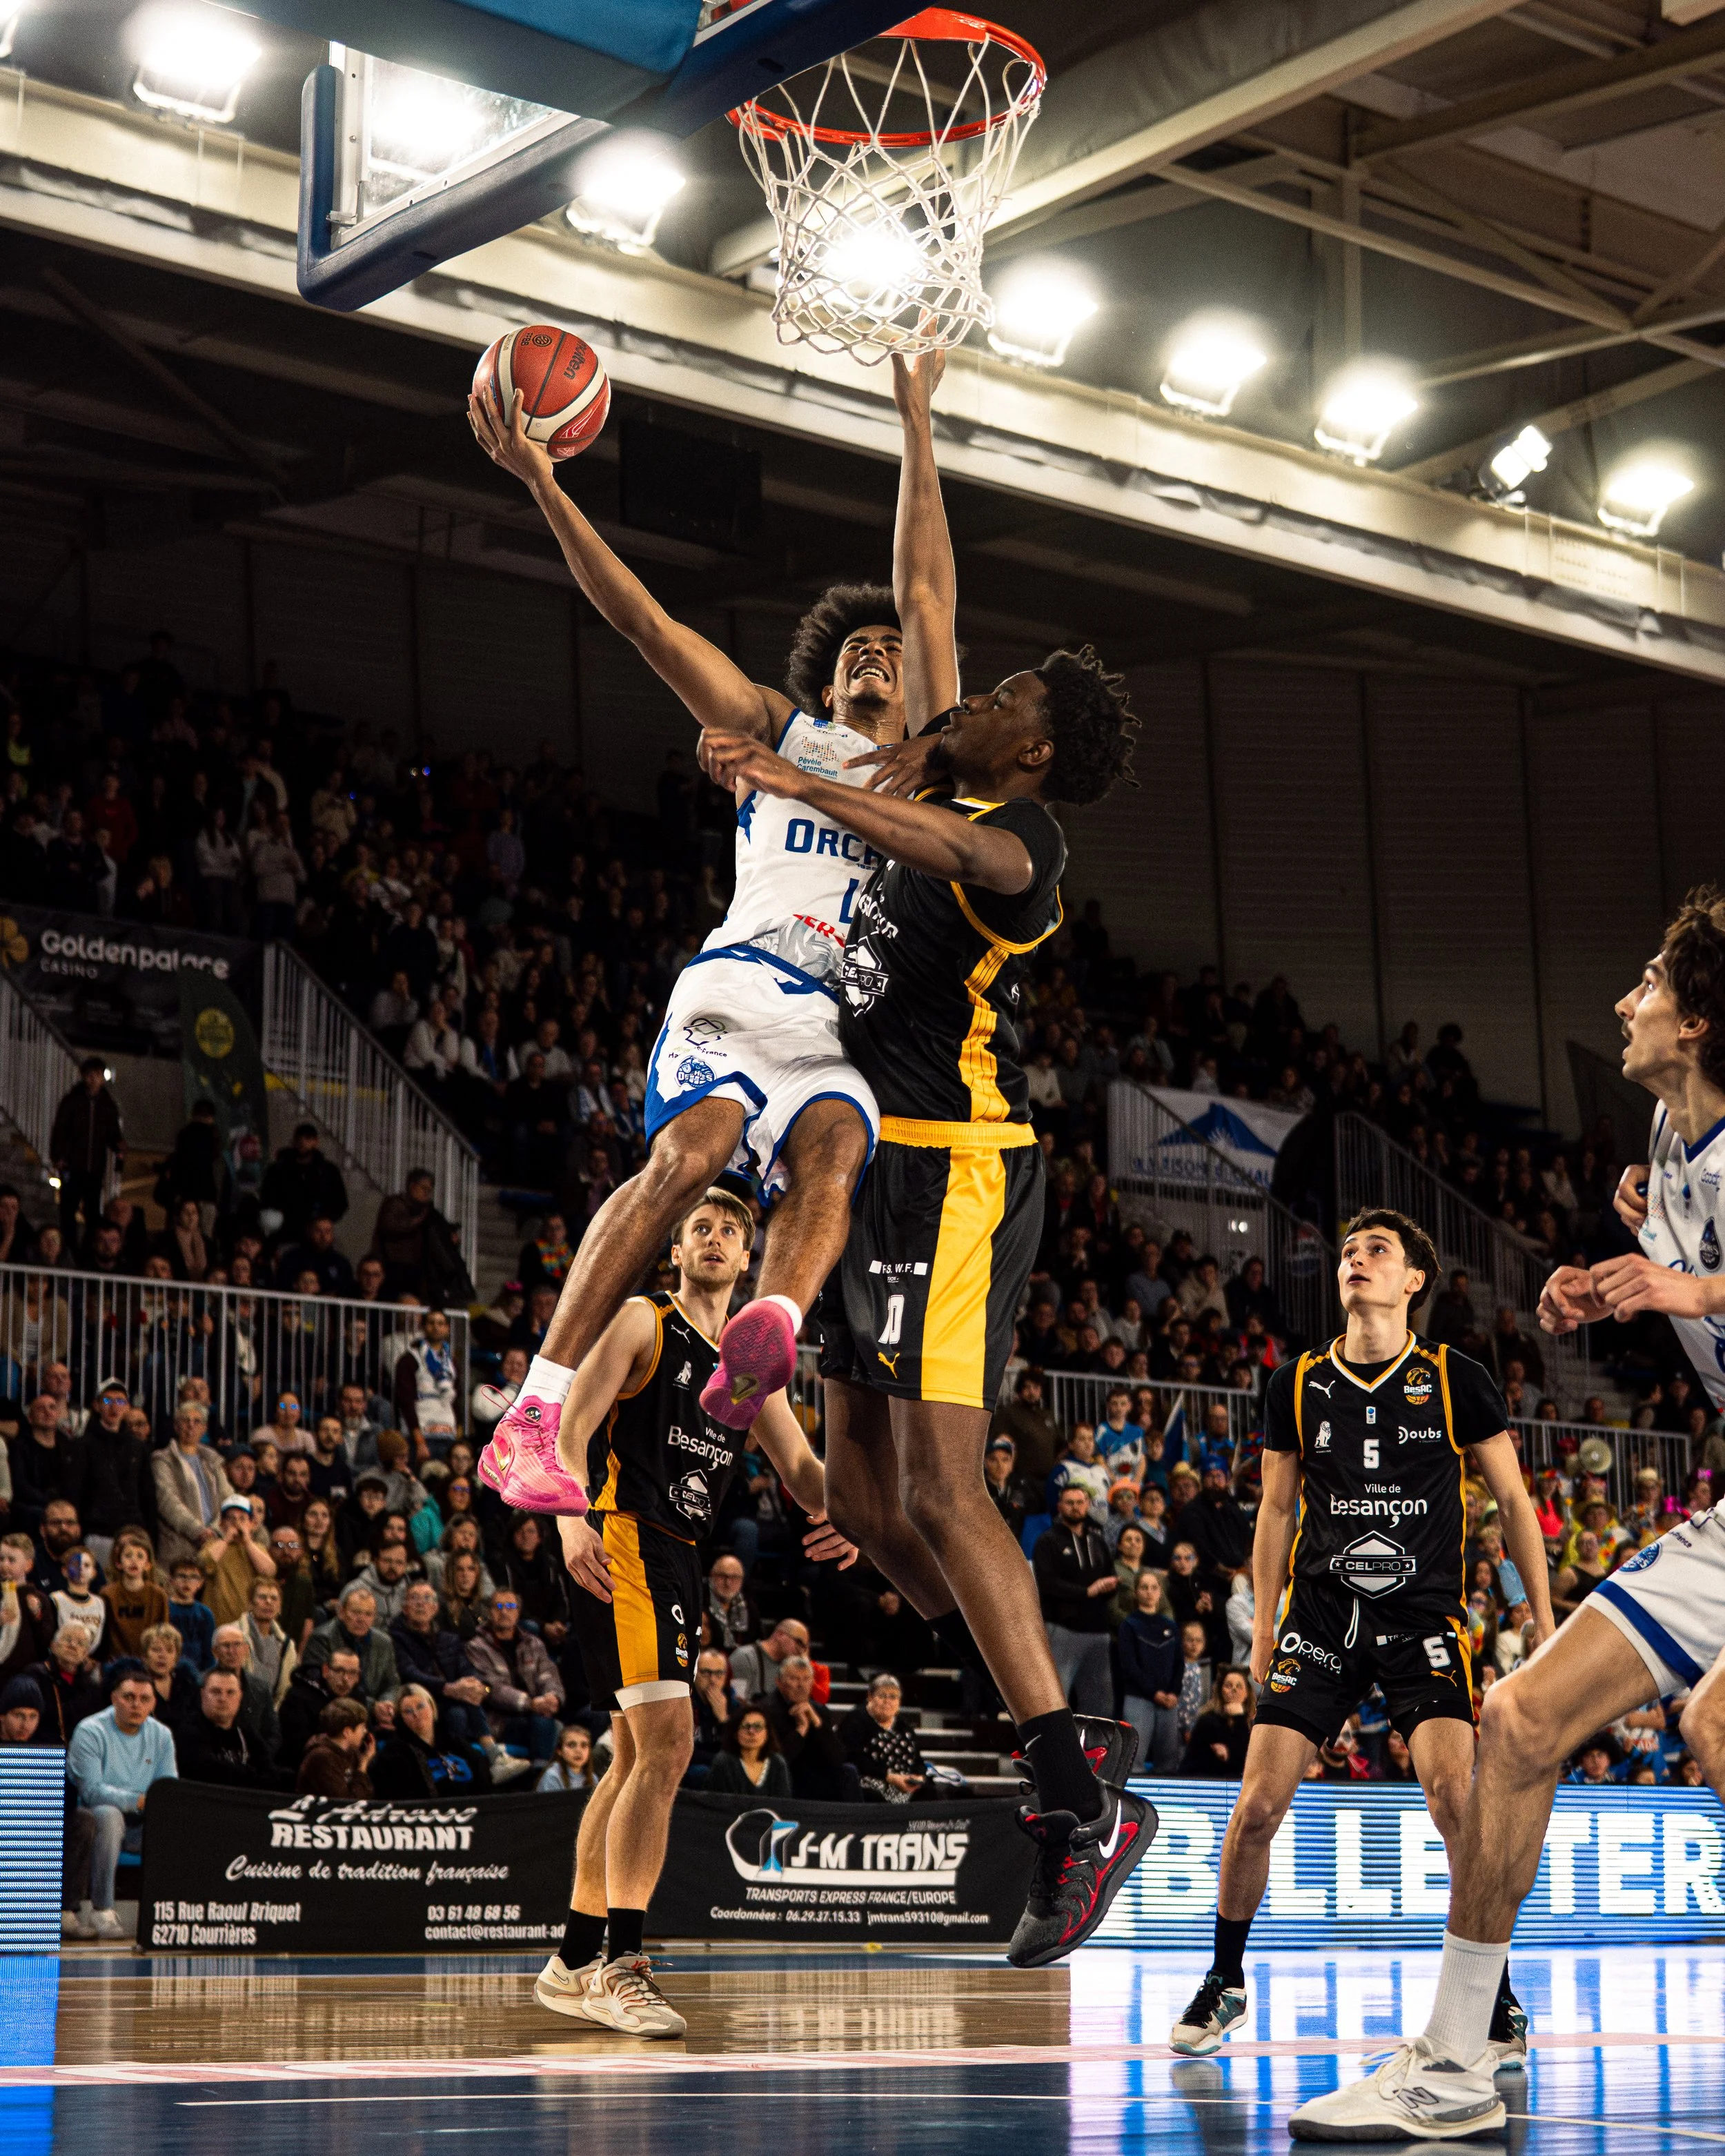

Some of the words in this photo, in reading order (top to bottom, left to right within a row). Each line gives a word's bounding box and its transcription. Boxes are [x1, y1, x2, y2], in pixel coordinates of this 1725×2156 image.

[667, 1425, 733, 1470] Besançon
[717, 1434, 725, 1443] de
[1363, 1438, 1379, 1469] 5
[1364, 1483, 1386, 1494] Ville
[1388, 1484, 1401, 1494] de
[1345, 1560, 1401, 1572] CELPRO
[1280, 1632, 1342, 1670] Opera
[1423, 1636, 1451, 1668] 5
[270, 1823, 475, 1851] RESTAURANT
[860, 1832, 970, 1871] TRANS
[1138, 1806, 1725, 1918] BLLETER
[225, 1854, 303, 1882] Cuisine
[308, 1859, 331, 1880] de
[337, 1859, 421, 1881] tradition
[425, 1860, 509, 1887] française
[746, 1886, 818, 1904] TRANSPORTS
[819, 1890, 866, 1905] EXPRESS
[867, 1890, 956, 1906] FRANCE/EUROPE
[153, 1901, 175, 1921] 115
[178, 1901, 204, 1921] Rue
[208, 1901, 248, 1922] Raoul
[250, 1902, 302, 1926] Briquet
[427, 1905, 445, 1921] 03
[448, 1905, 463, 1921] 61
[464, 1905, 482, 1921] 48
[503, 1905, 521, 1921] 56
[786, 1910, 860, 1923] 06.29.37.15.33
[867, 1910, 989, 1926] jmtrans59310@gmail.com
[152, 1924, 189, 1946] 62710
[191, 1923, 257, 1946] Courrières
